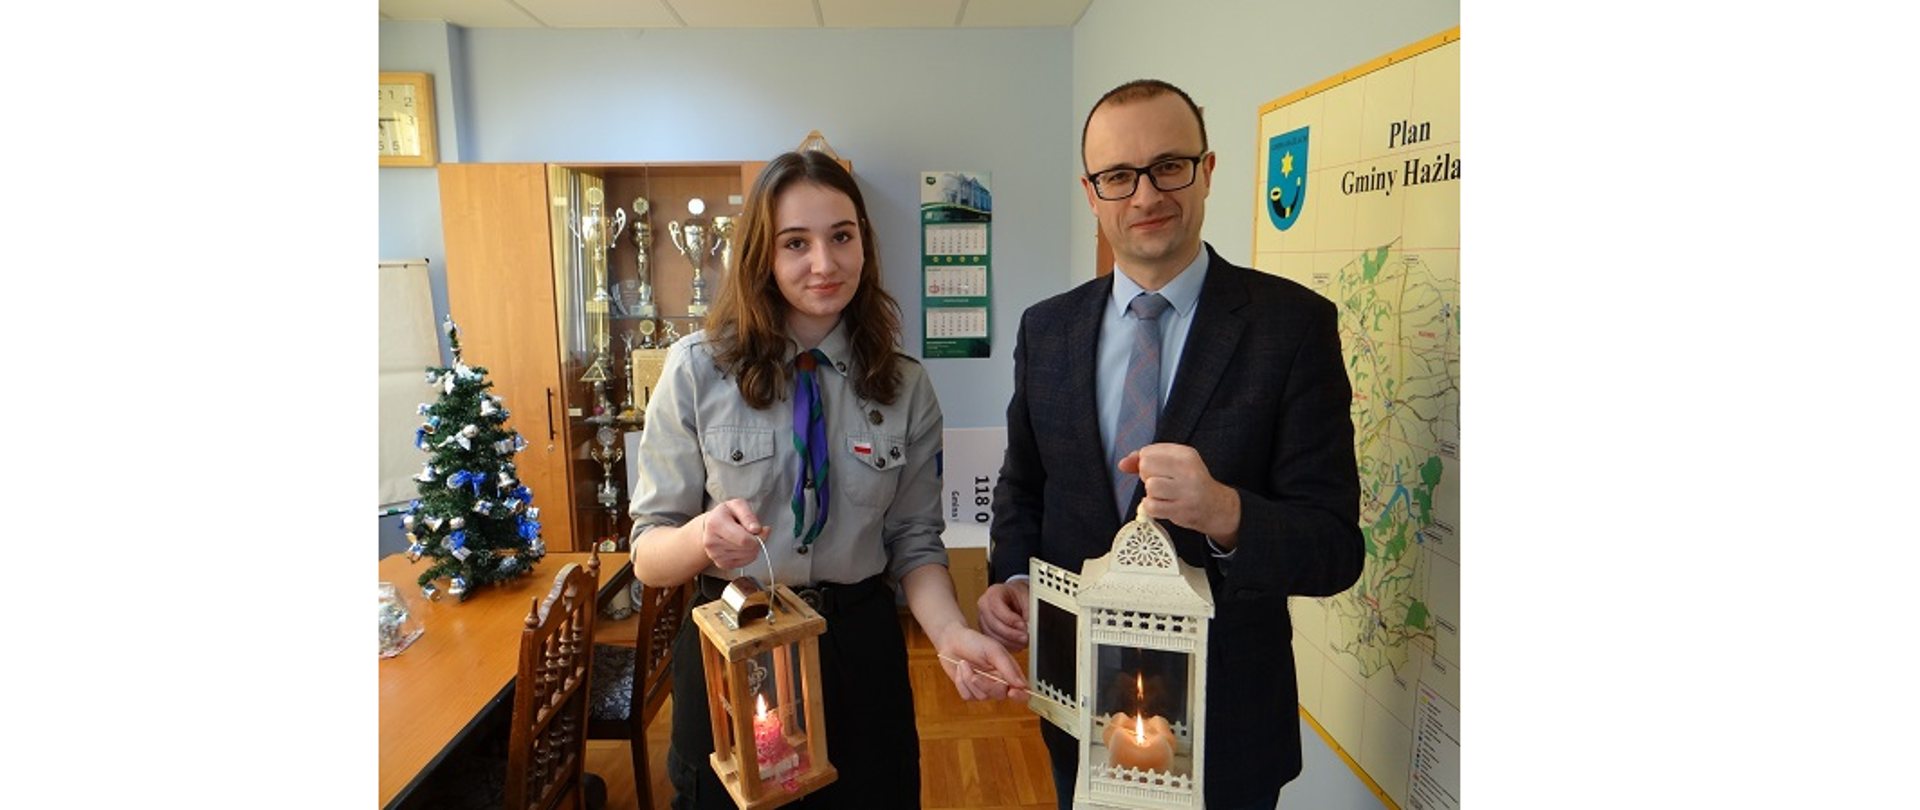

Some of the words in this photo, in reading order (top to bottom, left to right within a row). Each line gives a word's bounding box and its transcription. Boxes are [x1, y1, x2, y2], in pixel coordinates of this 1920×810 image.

[403, 97, 412, 107] 2
[1388, 120, 1430, 149] Plan
[1342, 166, 1397, 196] Gminy
[1402, 153, 1460, 187] Hażla
[975, 476, 990, 506] 118
